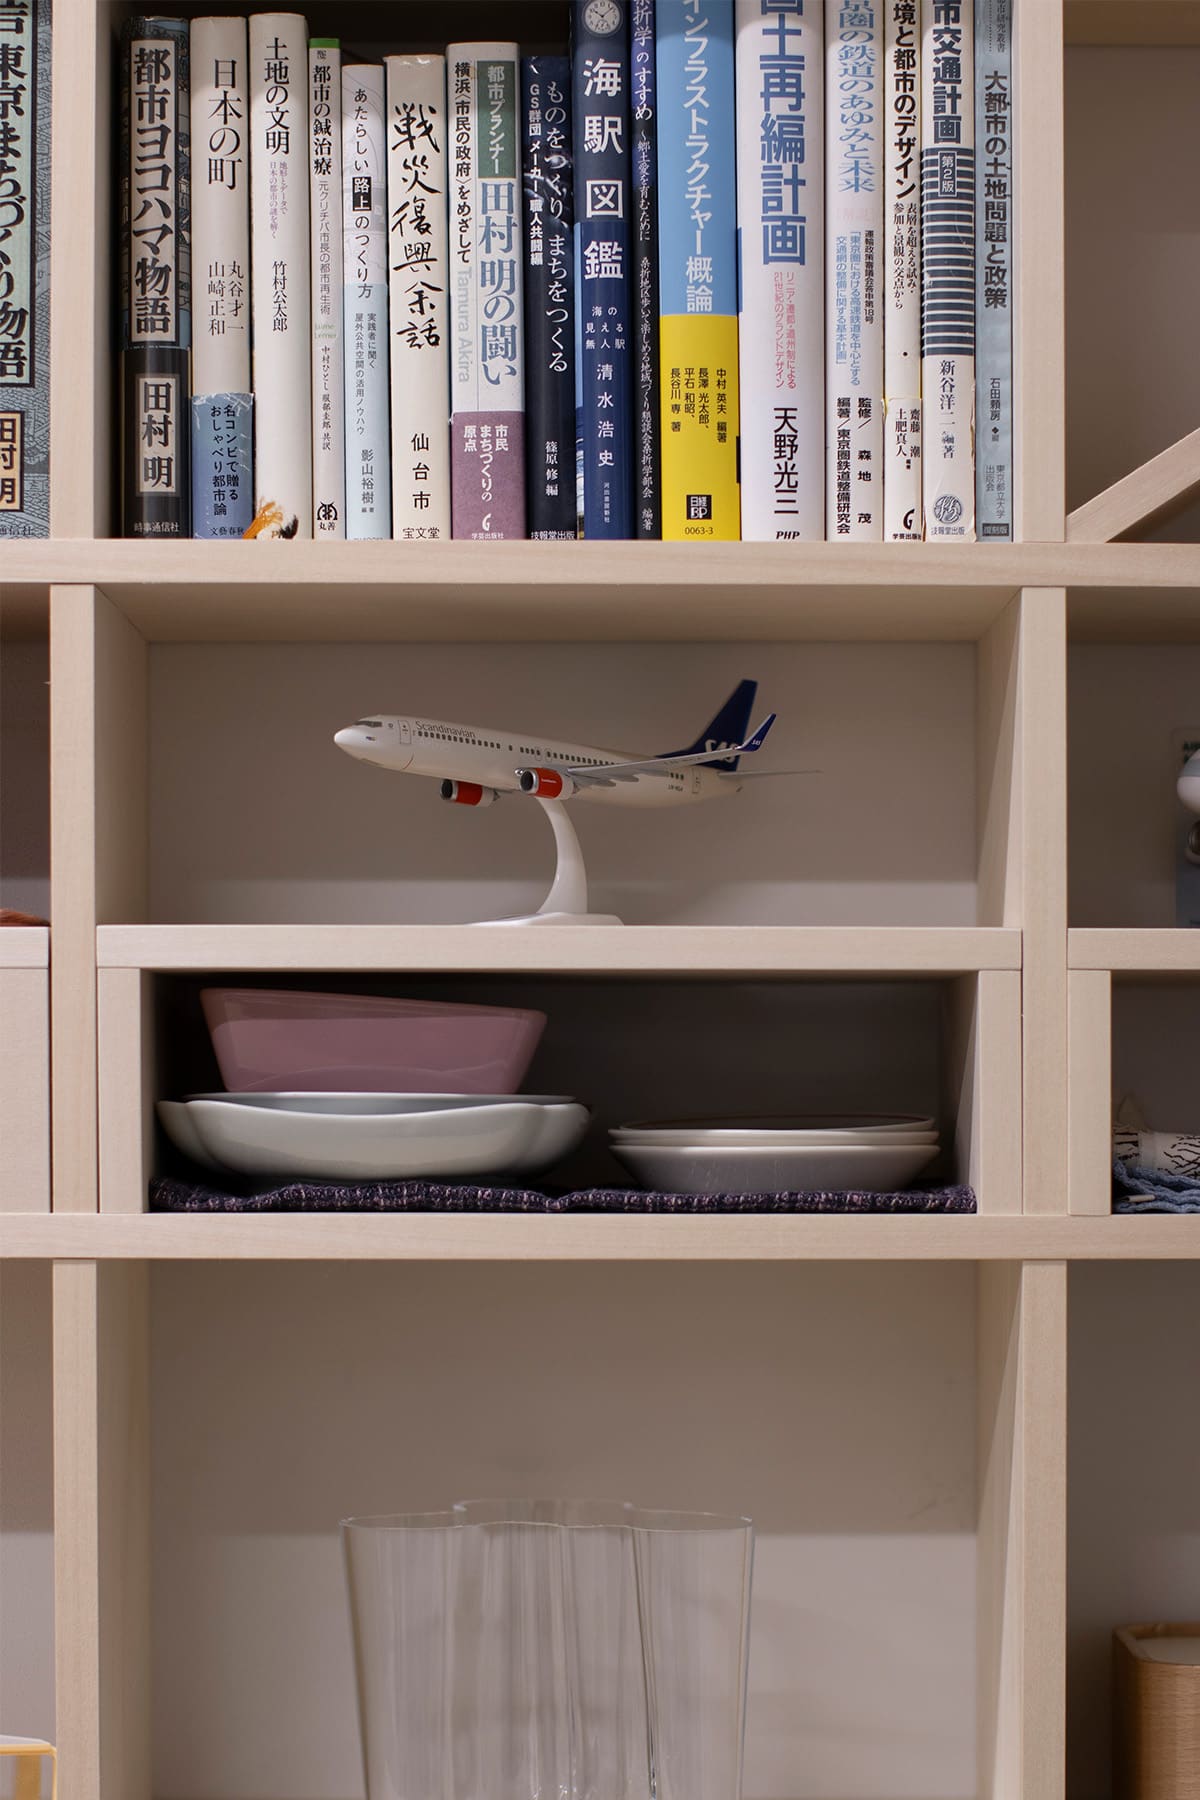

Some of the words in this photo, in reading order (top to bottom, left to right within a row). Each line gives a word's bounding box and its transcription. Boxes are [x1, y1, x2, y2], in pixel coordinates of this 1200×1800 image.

[208, 58, 243, 190] 日本の町
[264, 37, 290, 155] 土地の文明
[312, 65, 332, 176] 都市の鍼治療
[487, 65, 504, 175] 都市プランナー
[529, 84, 542, 136] GS群団
[892, 0, 917, 200] 境と都市のデザイン
[133, 48, 173, 334] 都市ヨコハマ物語
[583, 58, 624, 280] 海駅図鑑
[941, 155, 955, 193] 第2版
[984, 70, 1008, 309] 大都市の土地問題と政策
[318, 180, 331, 316] 元クリチバ市長の都市再生術
[544, 81, 569, 373] ものをつくり、まちをつくる
[893, 203, 905, 310] 参加と景観の交点から
[208, 262, 226, 337] 山崎正和
[228, 261, 244, 330] 丸谷才一
[272, 261, 288, 332] 竹村公太郎
[457, 266, 471, 333] Tamura
[479, 182, 517, 386] 田村明の闘い
[592, 306, 618, 316] 海の
[367, 313, 377, 369] 実践者に聞く
[458, 335, 473, 382] Akira
[585, 322, 624, 333] 見える
[585, 338, 626, 350] 無人駅
[355, 313, 365, 435] 屋外公共空間の活用ノウハウ
[990, 377, 1001, 421] 石田頼房
[464, 425, 477, 452] 原点
[495, 425, 509, 451] 市民
[596, 363, 615, 467] 清水浩史
[895, 408, 907, 457] 土肥真人
[210, 405, 227, 515] おしゃべり都市論
[224, 404, 239, 501] 名コンビで贈る
[361, 449, 374, 504] 影山裕樹
[411, 432, 431, 510] 仙台市
[479, 425, 493, 502] まちづくりの
[773, 407, 800, 515] 天野光三
[985, 465, 995, 492] 出版会
[319, 522, 336, 531] 丸善
[996, 465, 1006, 519] 東京都立大学
[134, 521, 180, 533] 時事通信社
[402, 527, 440, 539] 宝文堂
[684, 527, 714, 535] 0063-3
[775, 531, 801, 540] PHP
[415, 720, 476, 738] Scandinavian
